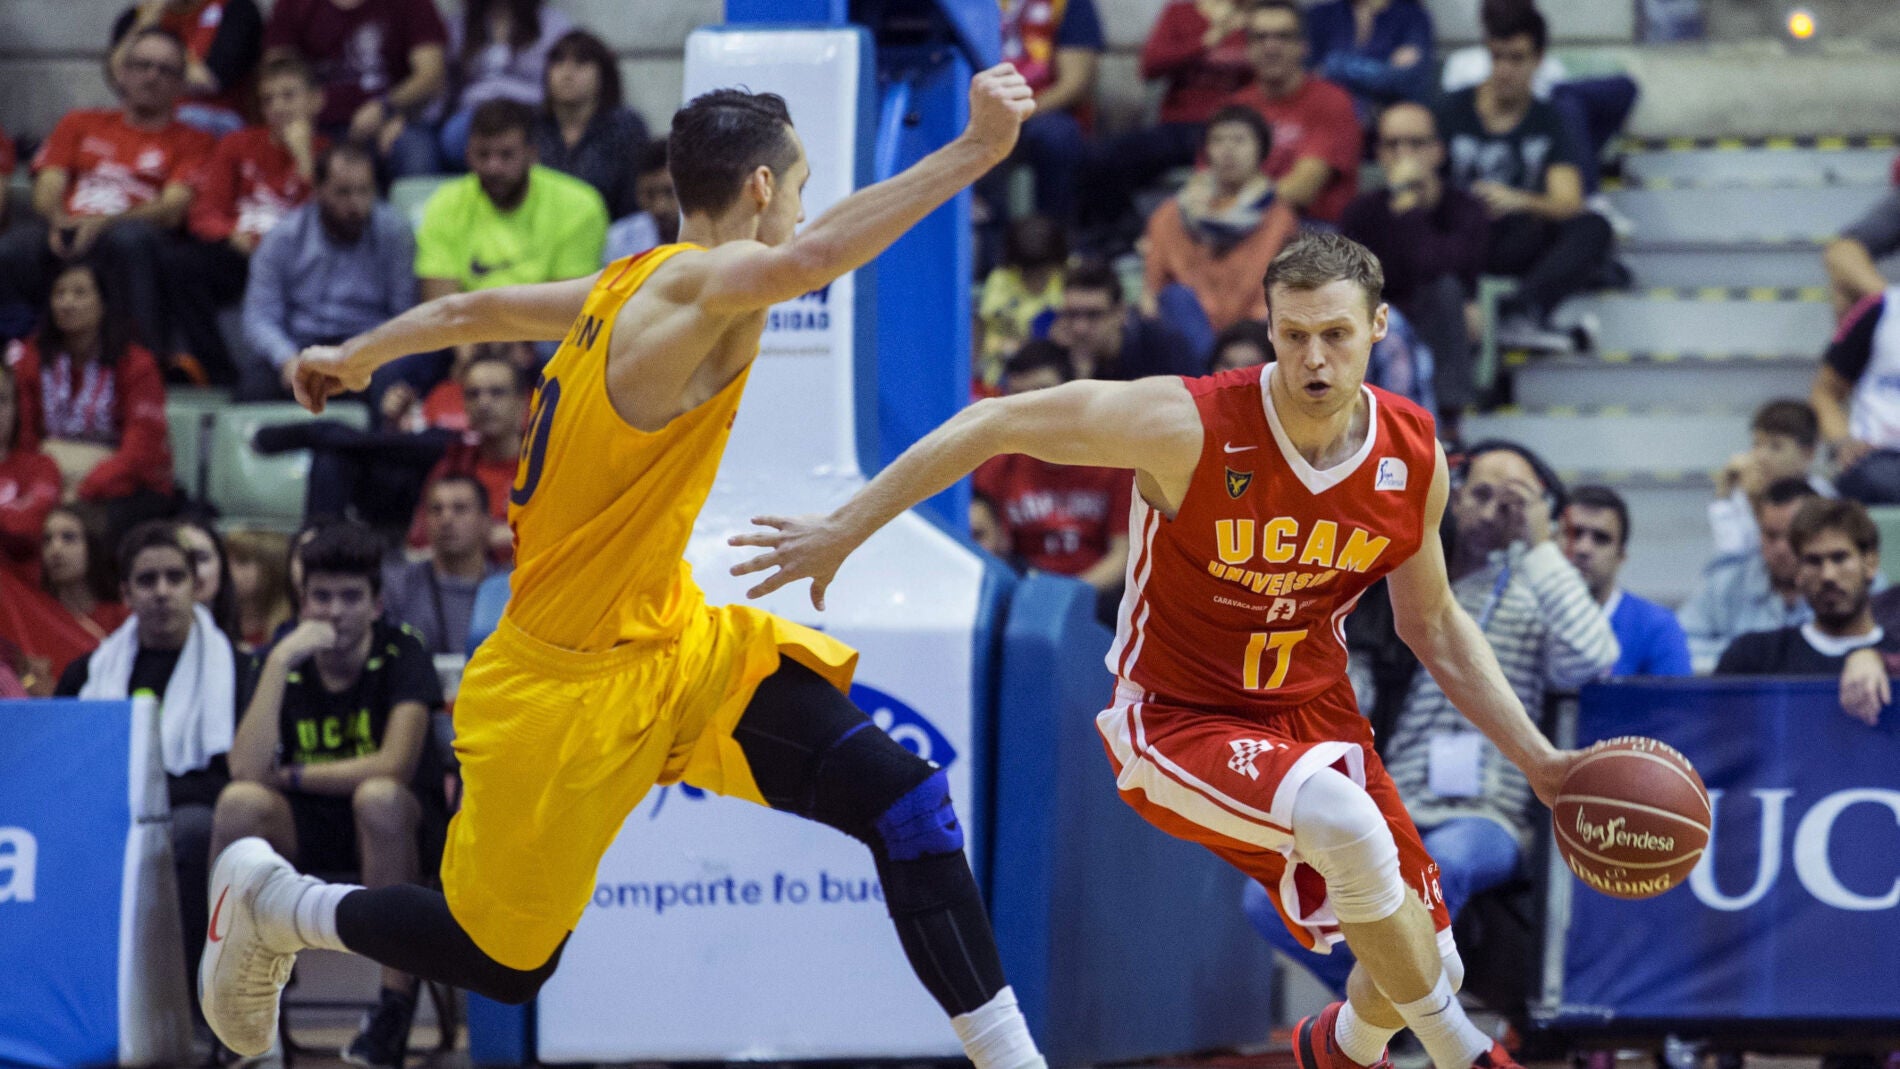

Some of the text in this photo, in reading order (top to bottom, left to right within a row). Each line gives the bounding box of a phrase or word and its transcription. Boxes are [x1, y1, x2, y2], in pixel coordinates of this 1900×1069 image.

[1215, 516, 1391, 573] UCAM
[1213, 595, 1250, 610] CARAVACA
[1243, 629, 1308, 690] 17
[1689, 787, 1900, 911] UC
[593, 874, 763, 914] omparte
